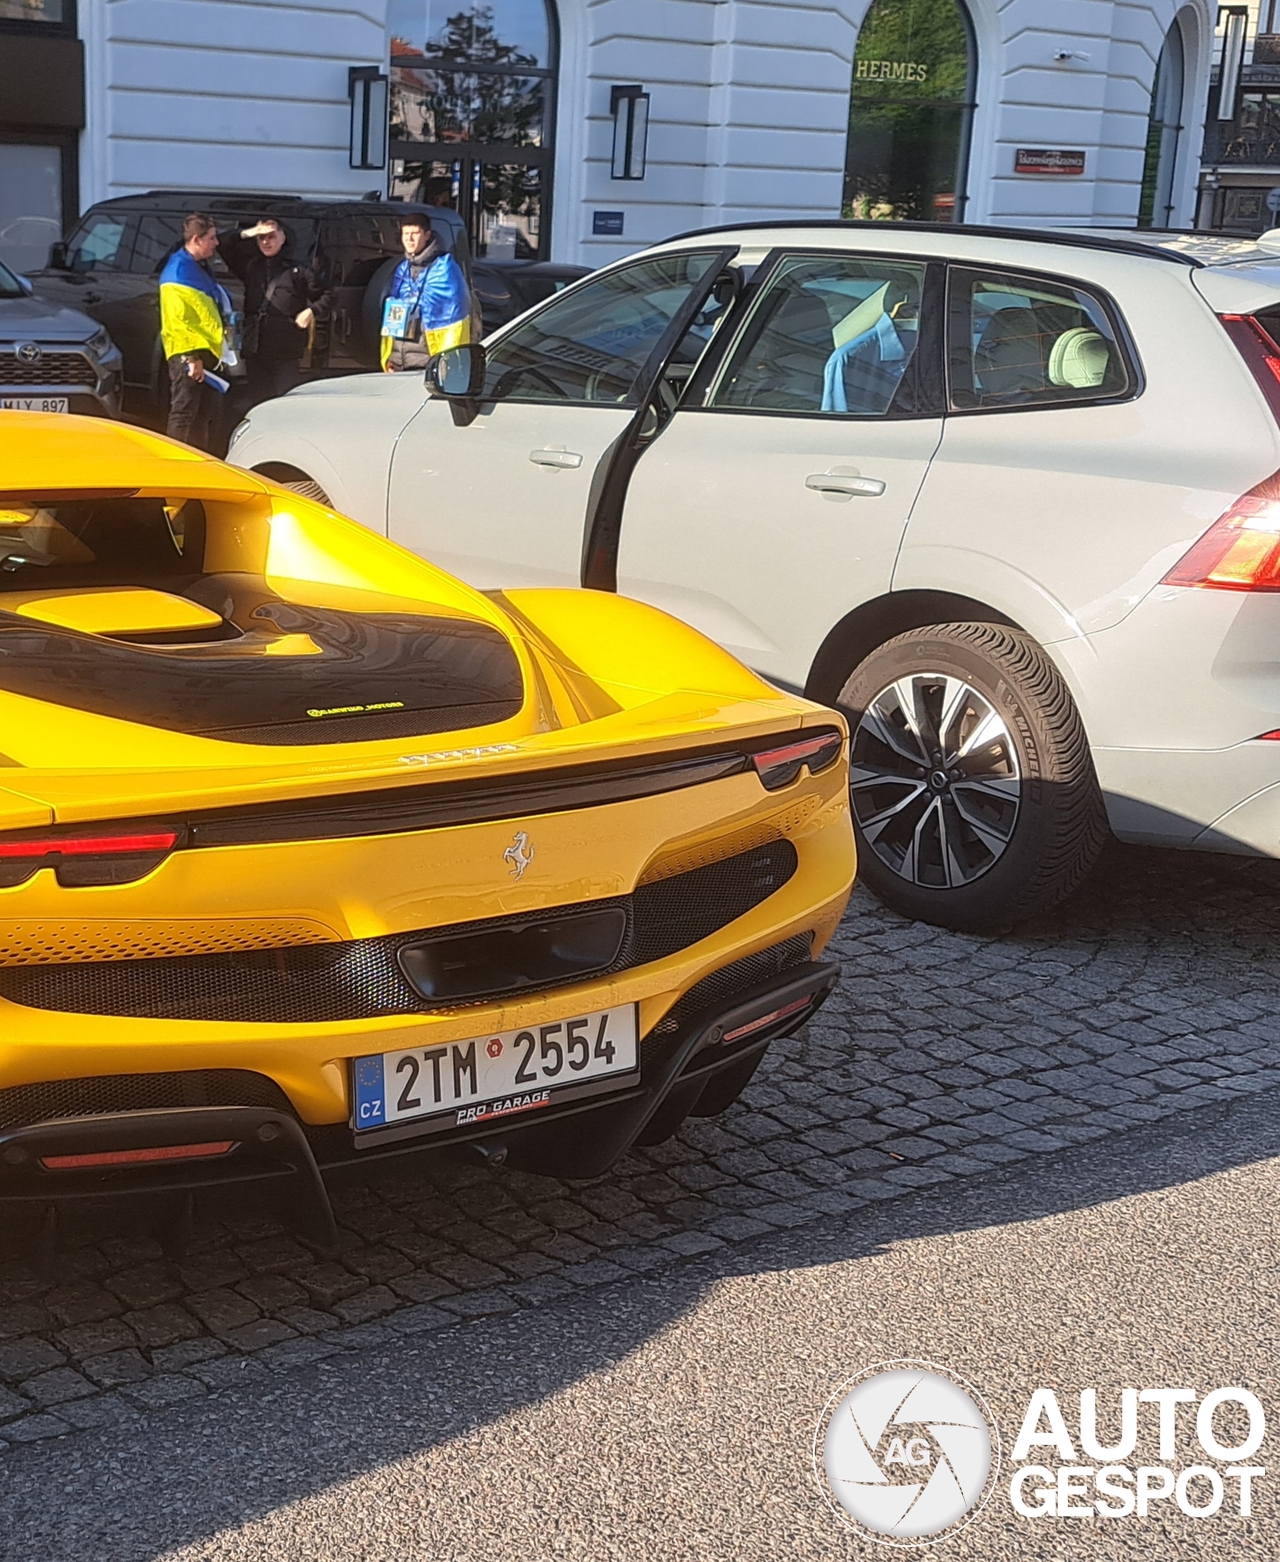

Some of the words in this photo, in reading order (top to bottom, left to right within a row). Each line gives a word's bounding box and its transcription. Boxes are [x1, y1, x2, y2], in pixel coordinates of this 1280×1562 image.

[42, 399, 66, 413] 897
[395, 1041, 478, 1112] 2TM
[513, 1014, 616, 1085] 2554
[360, 1100, 381, 1119] CZ
[457, 1104, 487, 1120] PRO
[492, 1090, 551, 1112] GARAGE
